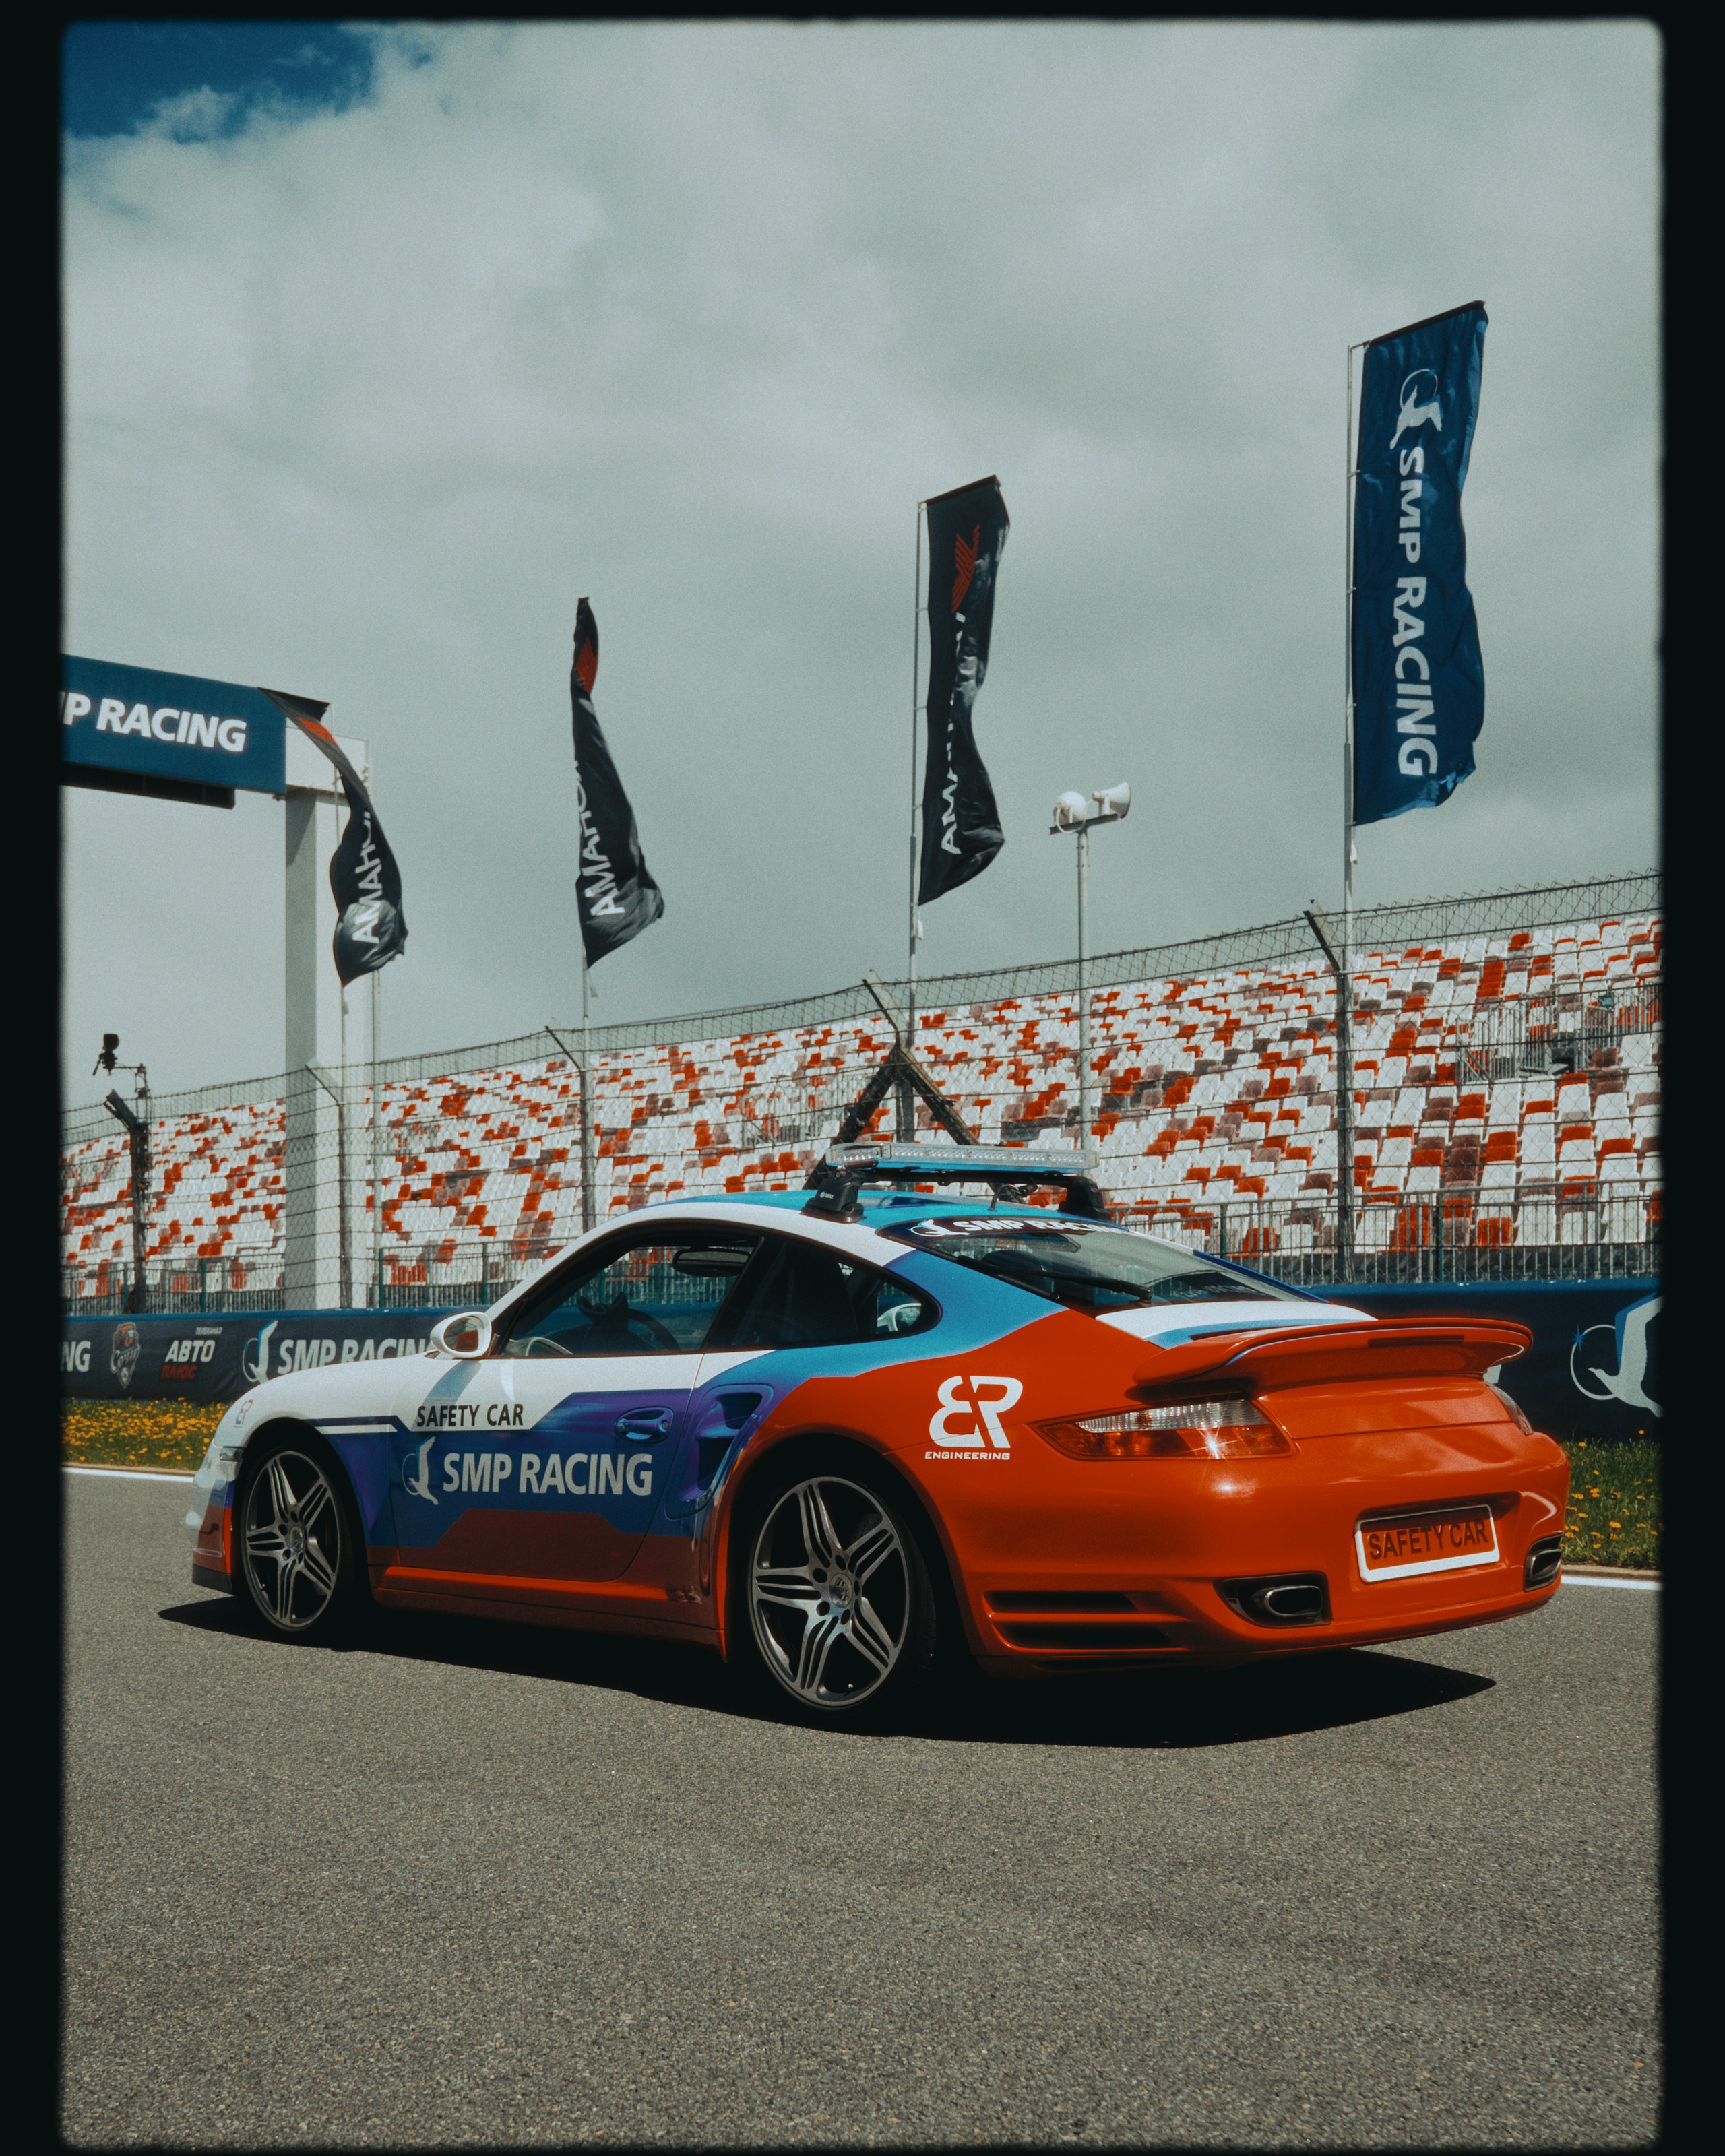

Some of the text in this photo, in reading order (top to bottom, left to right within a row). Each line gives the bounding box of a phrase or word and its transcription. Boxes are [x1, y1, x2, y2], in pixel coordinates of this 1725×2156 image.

[1392, 446, 1438, 776] SMP RACING
[61, 691, 247, 752] P RACING
[953, 1219, 1024, 1232] SMP
[164, 1340, 216, 1362] АВТО
[277, 1338, 433, 1375] SMP RACI
[161, 1365, 197, 1379] ПЛЮС
[416, 1403, 524, 1427] SAFETY CAR
[924, 1451, 1011, 1461] ENGINEERING
[443, 1452, 653, 1496] SMP RACING
[1368, 1519, 1489, 1560] SAFETY CAR
